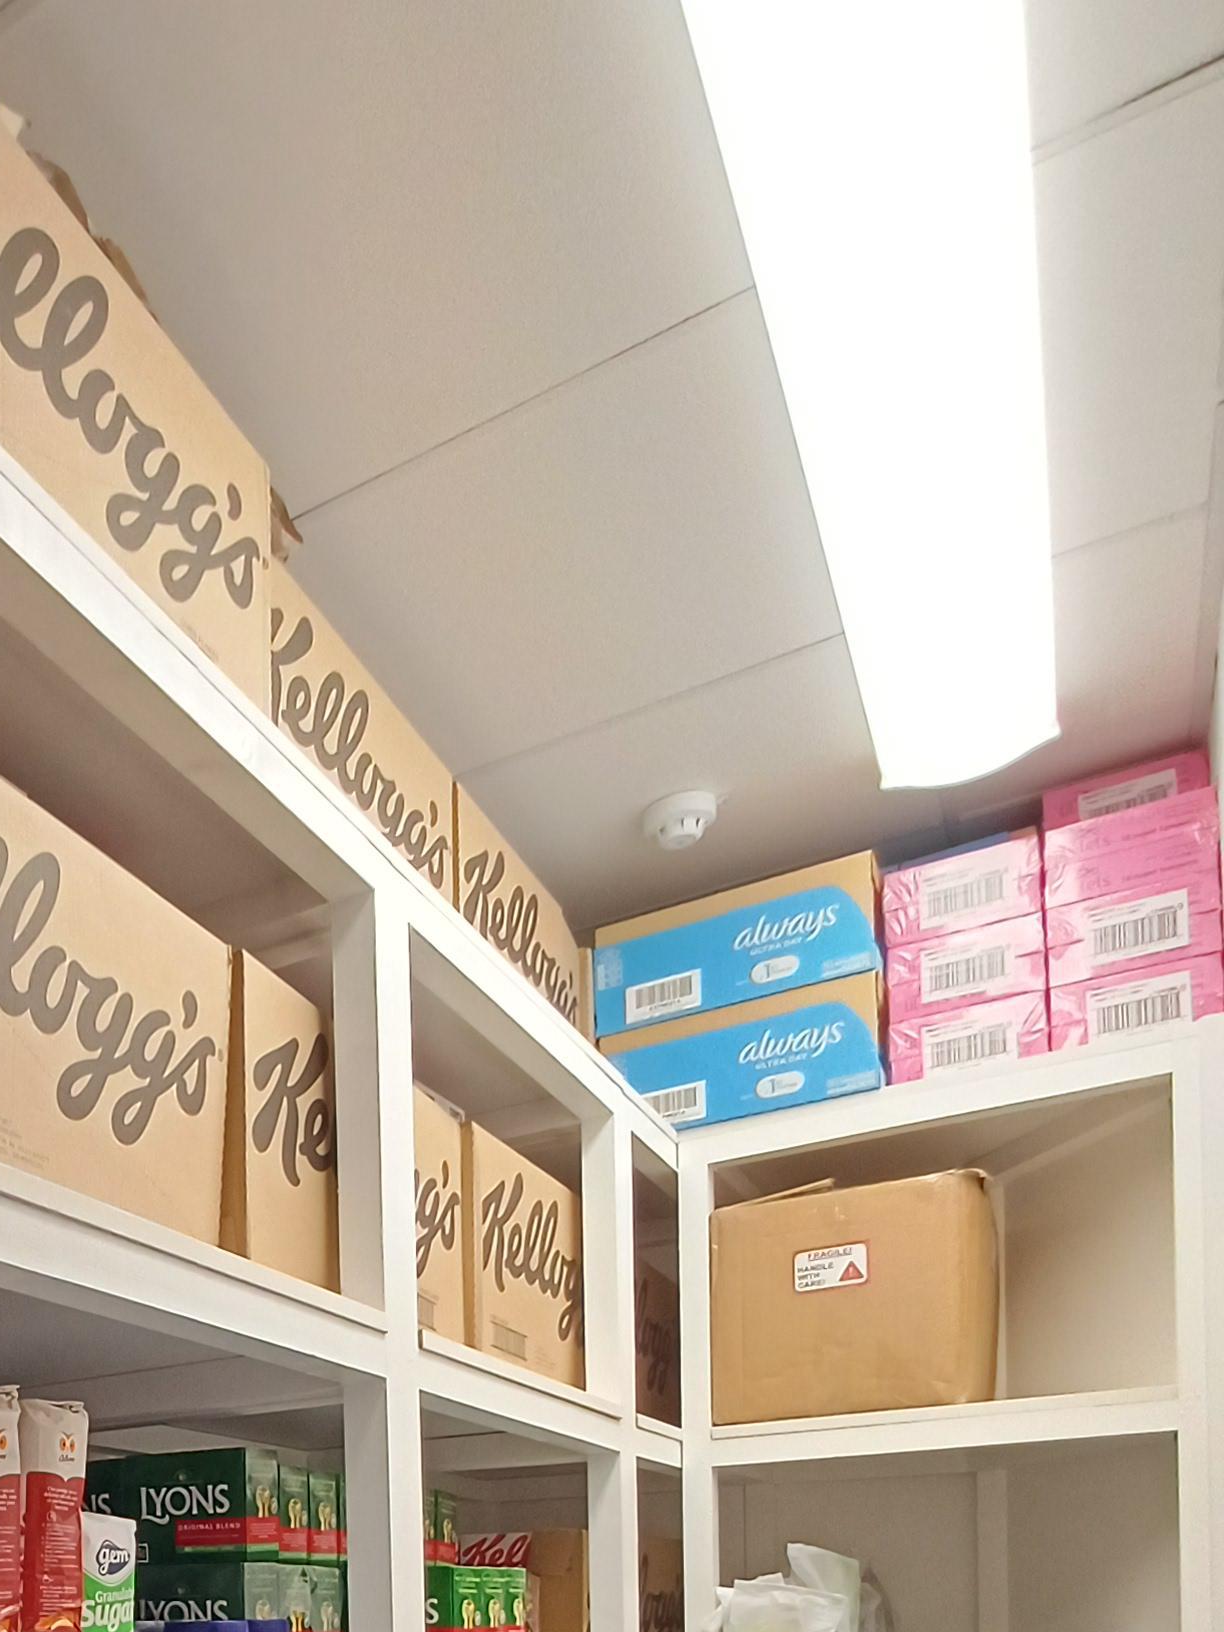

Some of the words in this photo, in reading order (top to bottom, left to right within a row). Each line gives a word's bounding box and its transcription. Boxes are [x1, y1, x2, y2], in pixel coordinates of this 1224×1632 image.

[733, 902, 841, 951] always
[738, 1018, 845, 1065] always
[139, 1484, 232, 1526] LYONS
[177, 1523, 214, 1532] ORIGINAL
[215, 1522, 242, 1531] BLEND
[98, 1545, 130, 1576] gem
